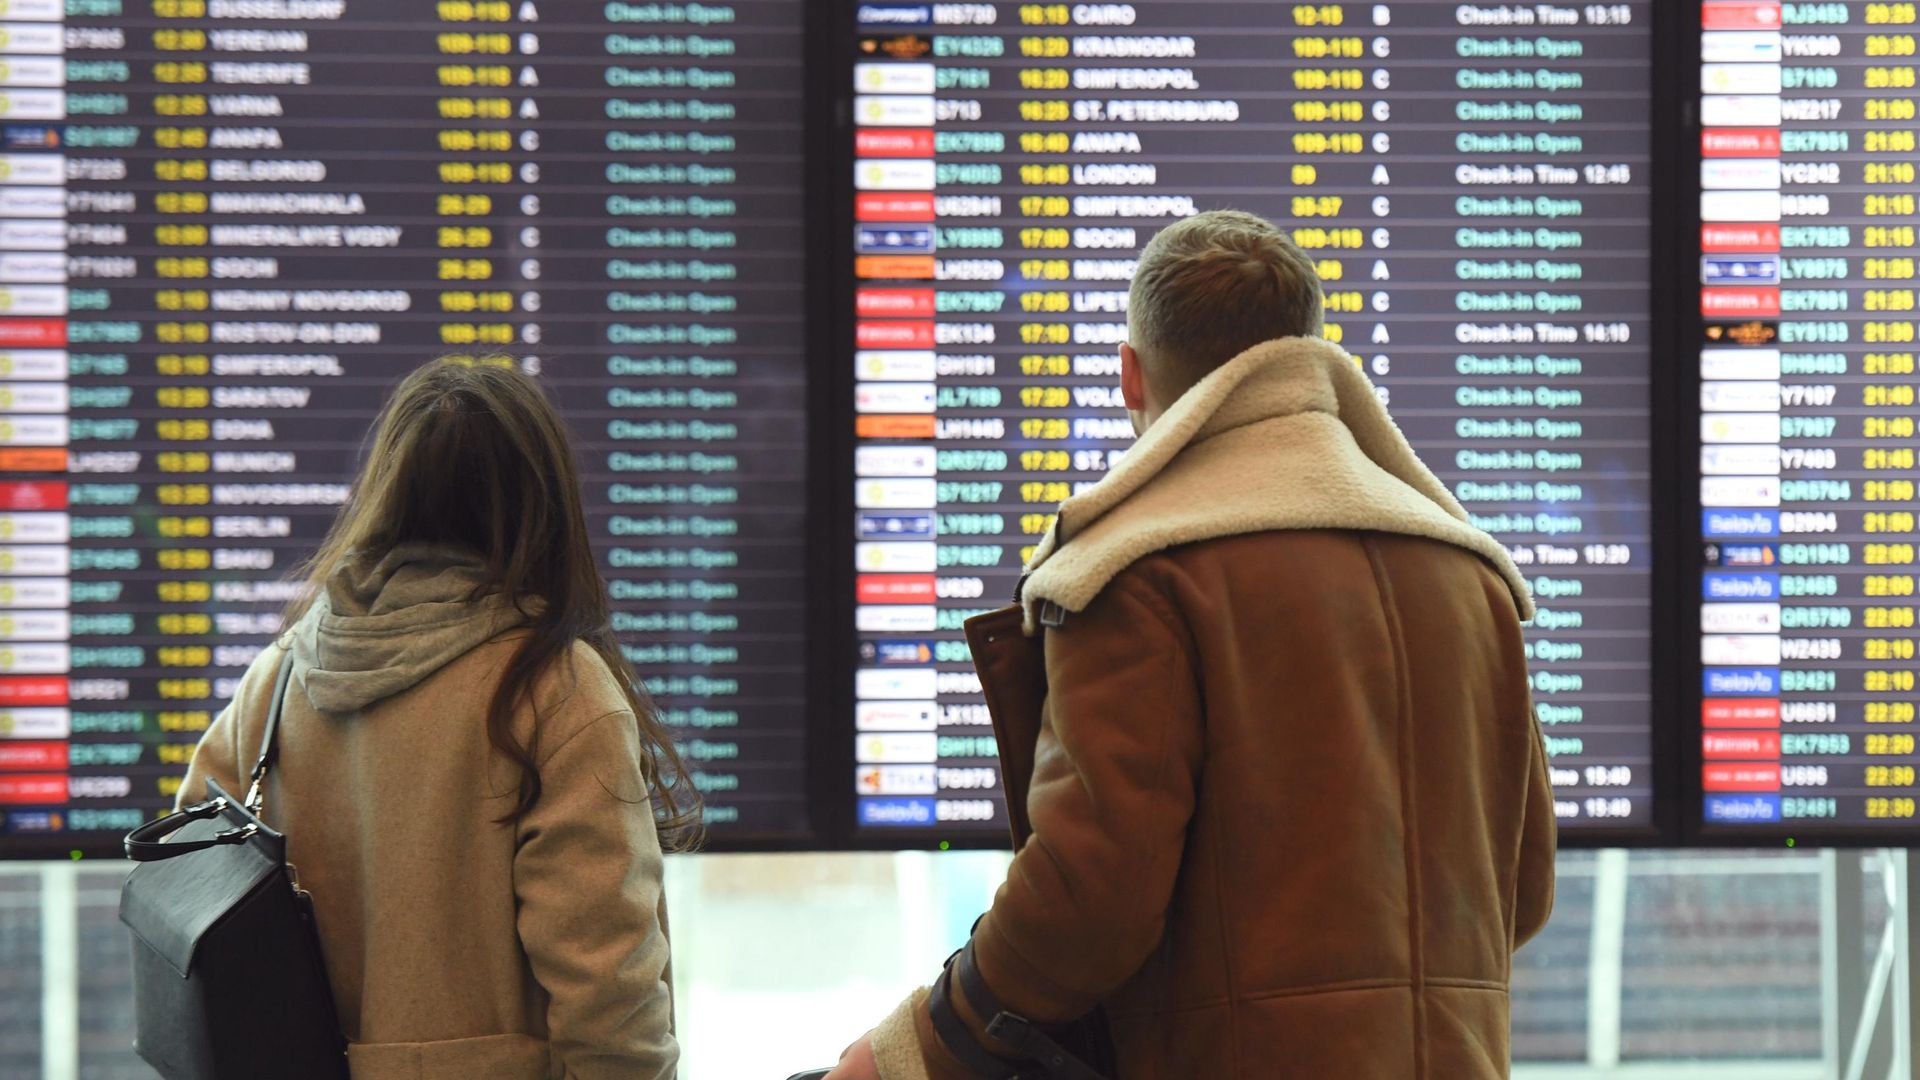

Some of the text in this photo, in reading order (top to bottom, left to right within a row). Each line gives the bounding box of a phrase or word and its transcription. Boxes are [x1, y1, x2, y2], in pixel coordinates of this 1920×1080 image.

[518, 1, 538, 21] A
[604, 2, 735, 24] Check-in Open
[1072, 4, 1136, 25] CAIRO
[1372, 4, 1391, 26] B
[1455, 4, 1535, 25] Check-in
[1535, 4, 1579, 25] Time
[209, 29, 308, 52] YEREVAN
[519, 32, 539, 55] B
[604, 34, 735, 56] Check-in Open
[1072, 36, 1196, 58] KRASNODAR
[1371, 36, 1390, 58] C
[1456, 37, 1583, 59] Check-in Open
[210, 62, 309, 85] TENERIFE
[519, 66, 539, 86] A
[604, 66, 735, 88] Check-in Open
[1073, 67, 1200, 90] SIMFEROPOL
[1371, 68, 1390, 90] C
[1456, 68, 1583, 91] Check-in Open
[209, 94, 283, 116] VARNA
[519, 98, 539, 118] A
[605, 98, 735, 121] Check-in Open
[1073, 99, 1240, 122] ST. PETERSBURG
[1371, 100, 1390, 122] C
[1455, 100, 1583, 123] Check-in Open
[210, 127, 282, 148] ANAPA
[519, 130, 539, 151] C
[605, 131, 736, 153] Check-in Open
[1072, 131, 1142, 153] ANAPA
[1371, 132, 1390, 153] C
[1455, 132, 1583, 155] Check-in Open
[210, 159, 326, 182] BELGOROD
[519, 162, 539, 184] C
[605, 163, 736, 185] Check-in Open
[1072, 163, 1157, 185] LONDON
[1371, 164, 1390, 185] A
[1455, 164, 1534, 184] Check-in
[1534, 163, 1578, 184] Time
[606, 195, 736, 217] Check-in Open
[1073, 195, 1199, 217] SIMFEROPOL
[1371, 195, 1390, 217] C
[1455, 196, 1582, 219] Check-in Open
[341, 225, 402, 247] VODY
[606, 227, 736, 249] Check-in Open
[1073, 228, 1136, 249] SOCHI
[1371, 227, 1390, 249] C
[1455, 227, 1582, 251] Check-in Open
[211, 257, 278, 279] SOCHI
[606, 259, 736, 281] Check-in Open
[1371, 259, 1390, 281] A
[1455, 259, 1582, 282] Check-in Open
[291, 290, 411, 312] NOVGOROD
[607, 292, 736, 313] Check-in Open
[1371, 291, 1390, 312] C
[1455, 291, 1582, 314] Check-in Open
[211, 321, 380, 344] ROSTOV-ON-DON
[607, 324, 736, 345] Check-in Open
[1371, 322, 1390, 344] A
[1455, 322, 1534, 343] Check-in
[1534, 322, 1578, 343] Time
[212, 354, 342, 376] SIMFEROPOL
[607, 355, 737, 377] Check-in Open
[1371, 355, 1391, 377] C
[1455, 354, 1582, 377] Check-in Open
[212, 386, 310, 408] SARATOV
[607, 387, 737, 409] Check-in Open
[1455, 386, 1582, 409] Check-in Open
[1455, 417, 1582, 441] Check-in Open
[212, 451, 295, 473] MUNICH
[608, 452, 737, 473] Check-in Open
[1455, 449, 1582, 473] Check-in Open
[1455, 480, 1582, 504] Check-in Open
[213, 515, 290, 538] BERLIN
[608, 515, 737, 538] Check-in Open
[1534, 512, 1582, 536] Open
[1534, 543, 1579, 565] Time
[609, 578, 738, 601] Check-in Open
[1534, 576, 1583, 599] Open
[611, 610, 738, 633] Check-in Open
[1534, 608, 1583, 631] Open
[1534, 640, 1583, 663] Open
[1534, 671, 1583, 694] Open
[684, 706, 738, 728] Open
